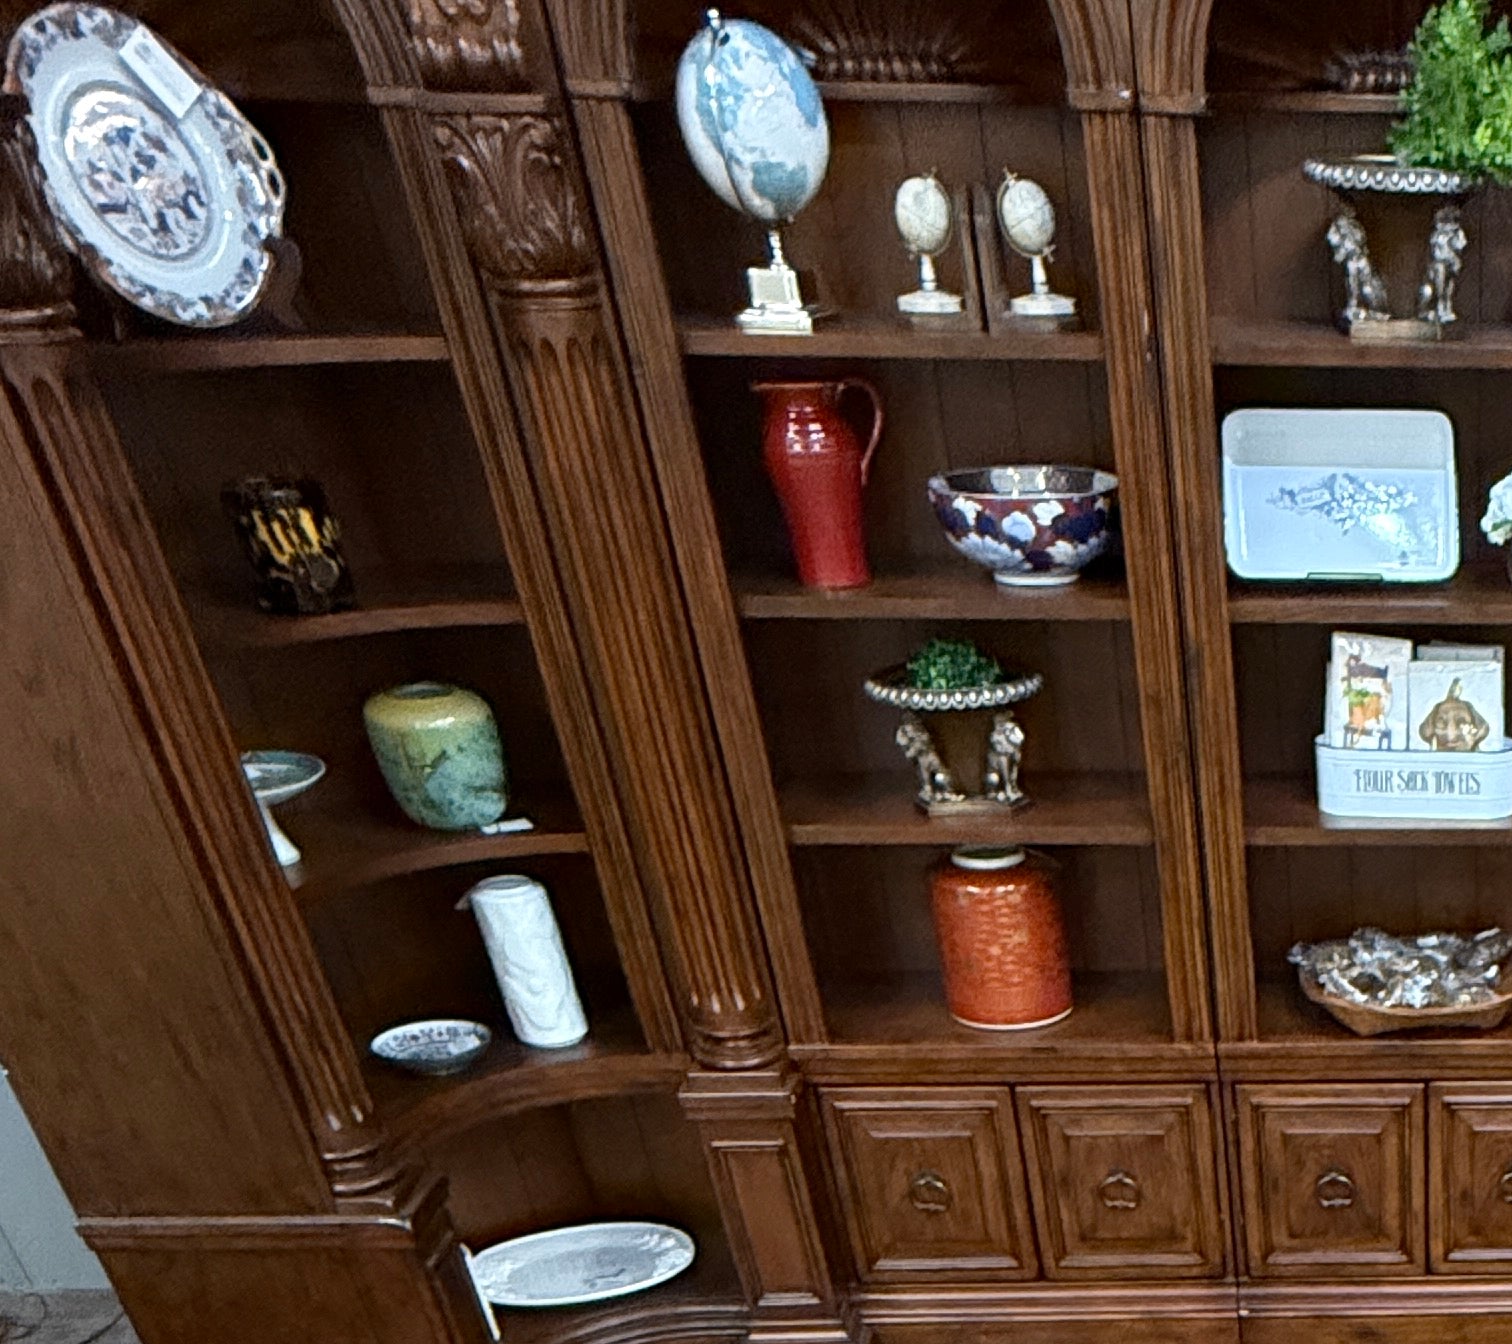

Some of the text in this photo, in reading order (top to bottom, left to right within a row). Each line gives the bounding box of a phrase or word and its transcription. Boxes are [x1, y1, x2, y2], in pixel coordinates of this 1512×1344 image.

[1354, 768, 1481, 796] FLOUR SACK TOWELS
